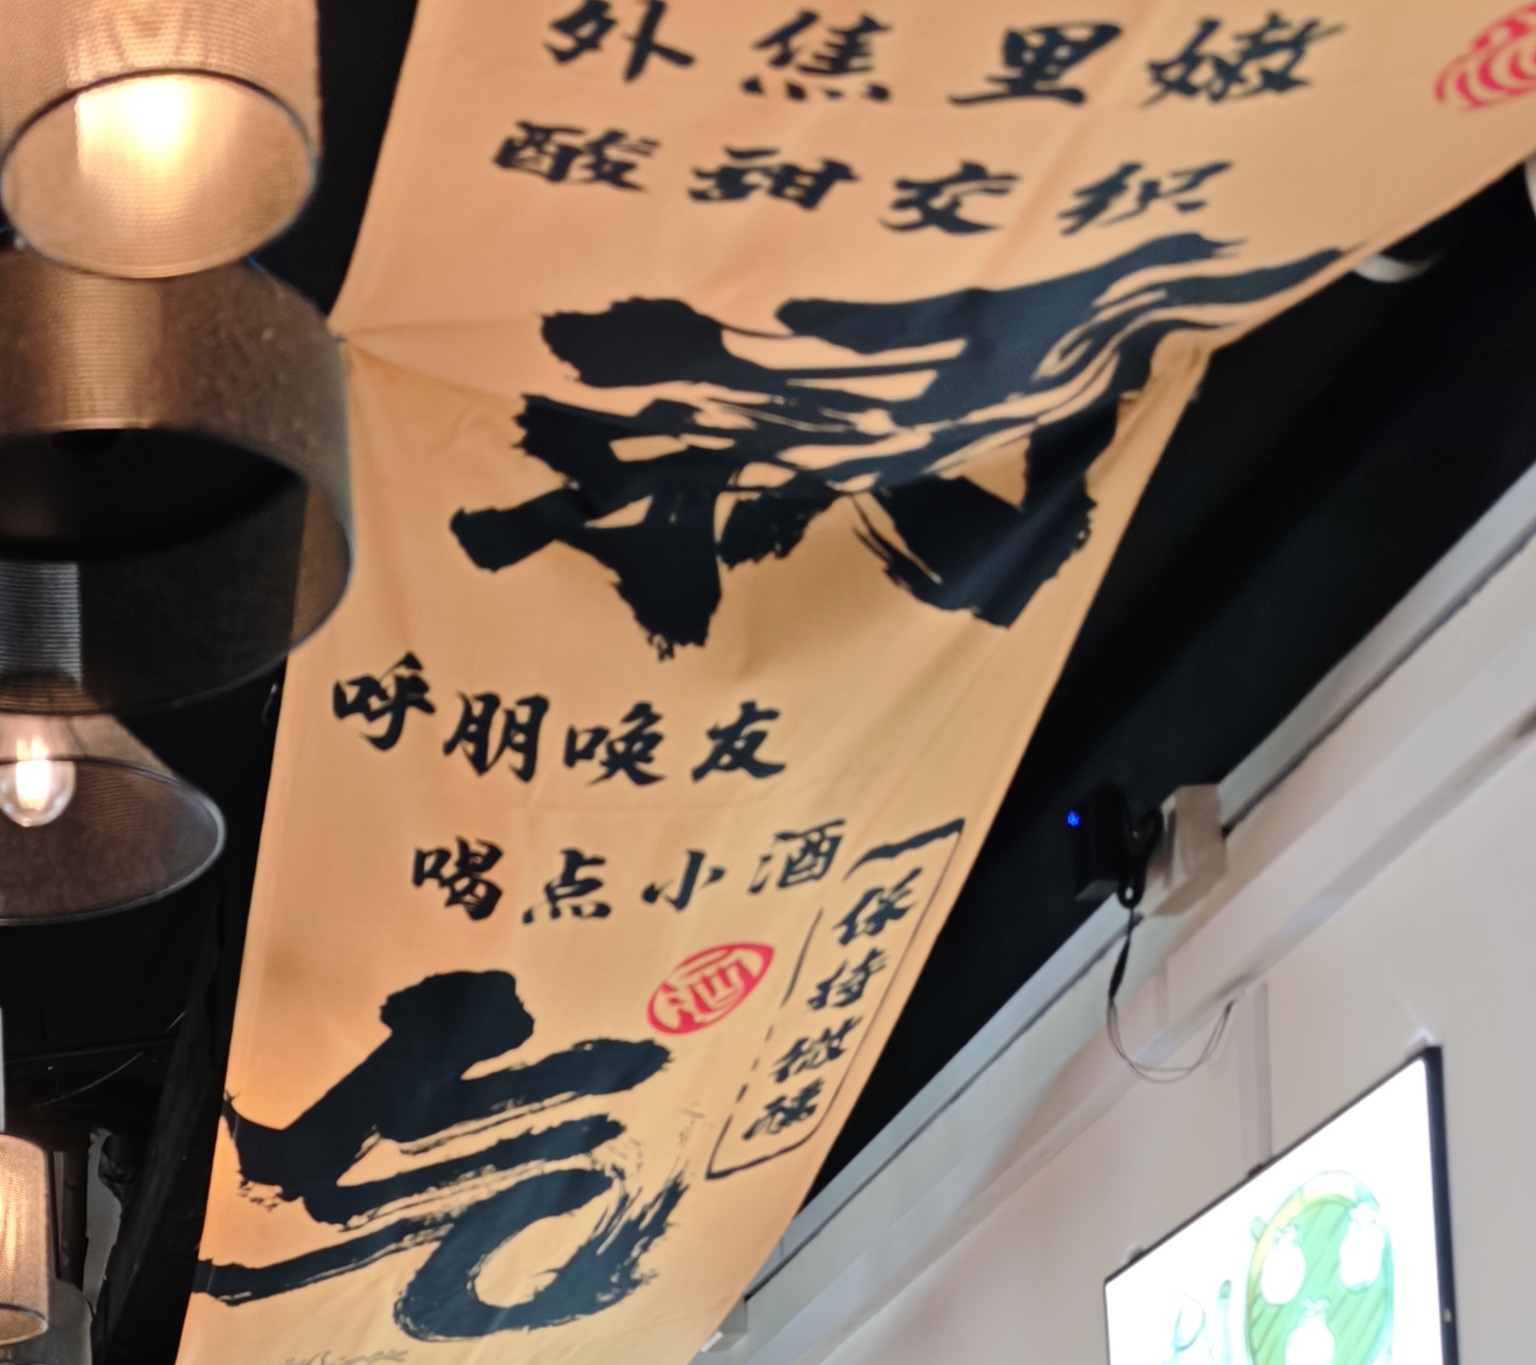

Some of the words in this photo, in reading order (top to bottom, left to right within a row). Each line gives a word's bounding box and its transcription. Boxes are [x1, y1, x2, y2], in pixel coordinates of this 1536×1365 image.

[542, 0, 1346, 106] 外焦里嫩
[491, 118, 1235, 236] 酸甜交织
[332, 651, 787, 789] 呼朋唤友
[411, 817, 847, 926] 喝点小酒
